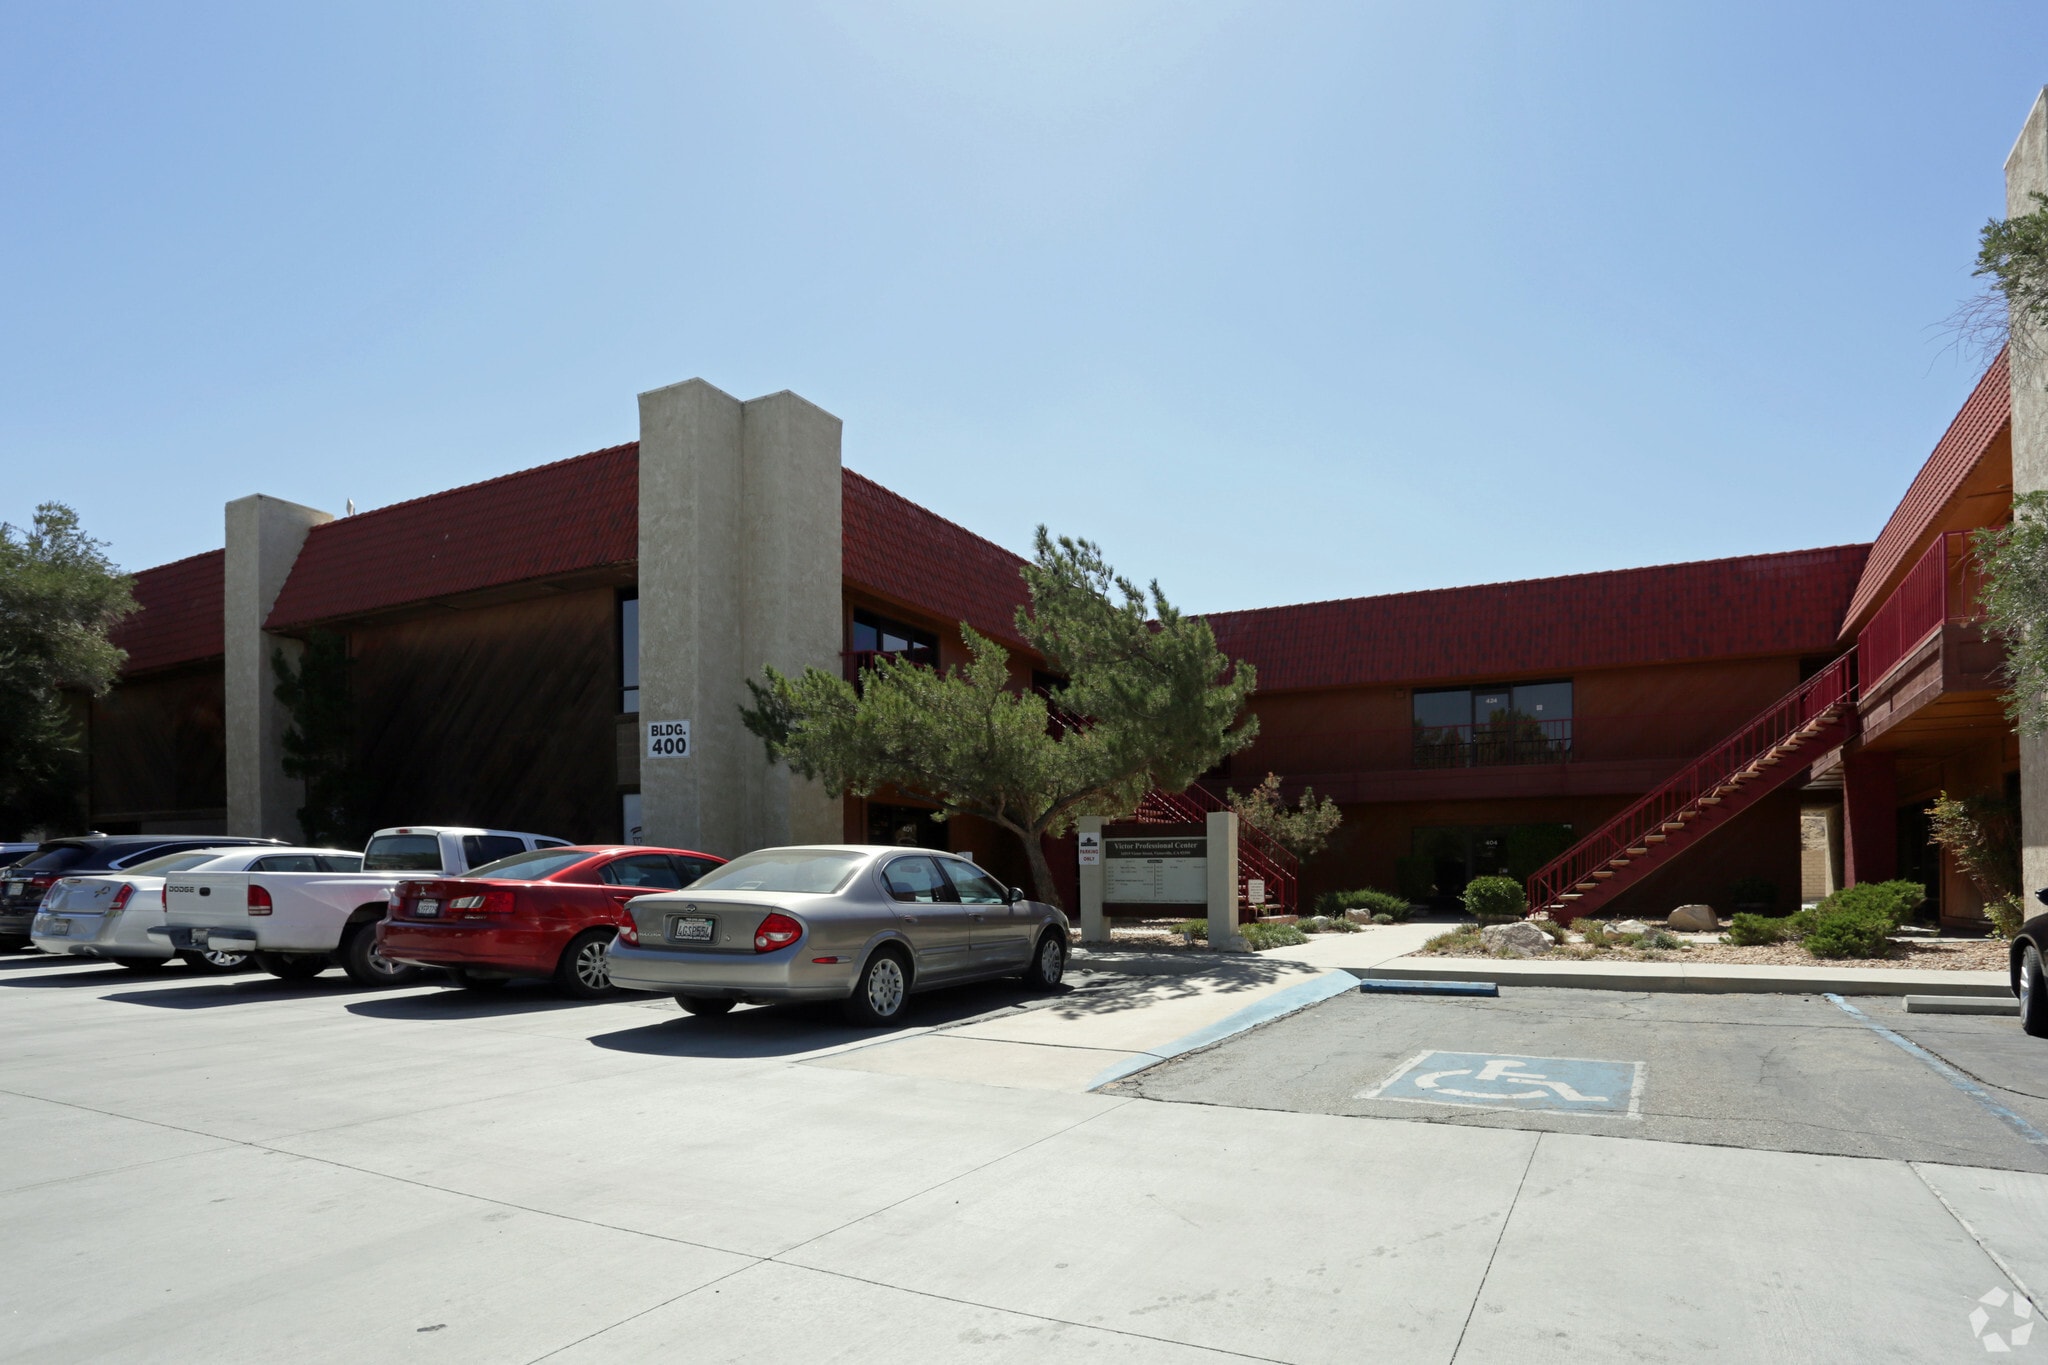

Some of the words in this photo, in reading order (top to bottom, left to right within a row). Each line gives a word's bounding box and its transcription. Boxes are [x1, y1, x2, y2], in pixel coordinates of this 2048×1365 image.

[651, 723, 686, 737] BLDG.
[652, 737, 687, 755] 400
[1114, 842, 1134, 850] Victor
[1174, 841, 1198, 849] Center
[168, 885, 195, 893] DODGE
